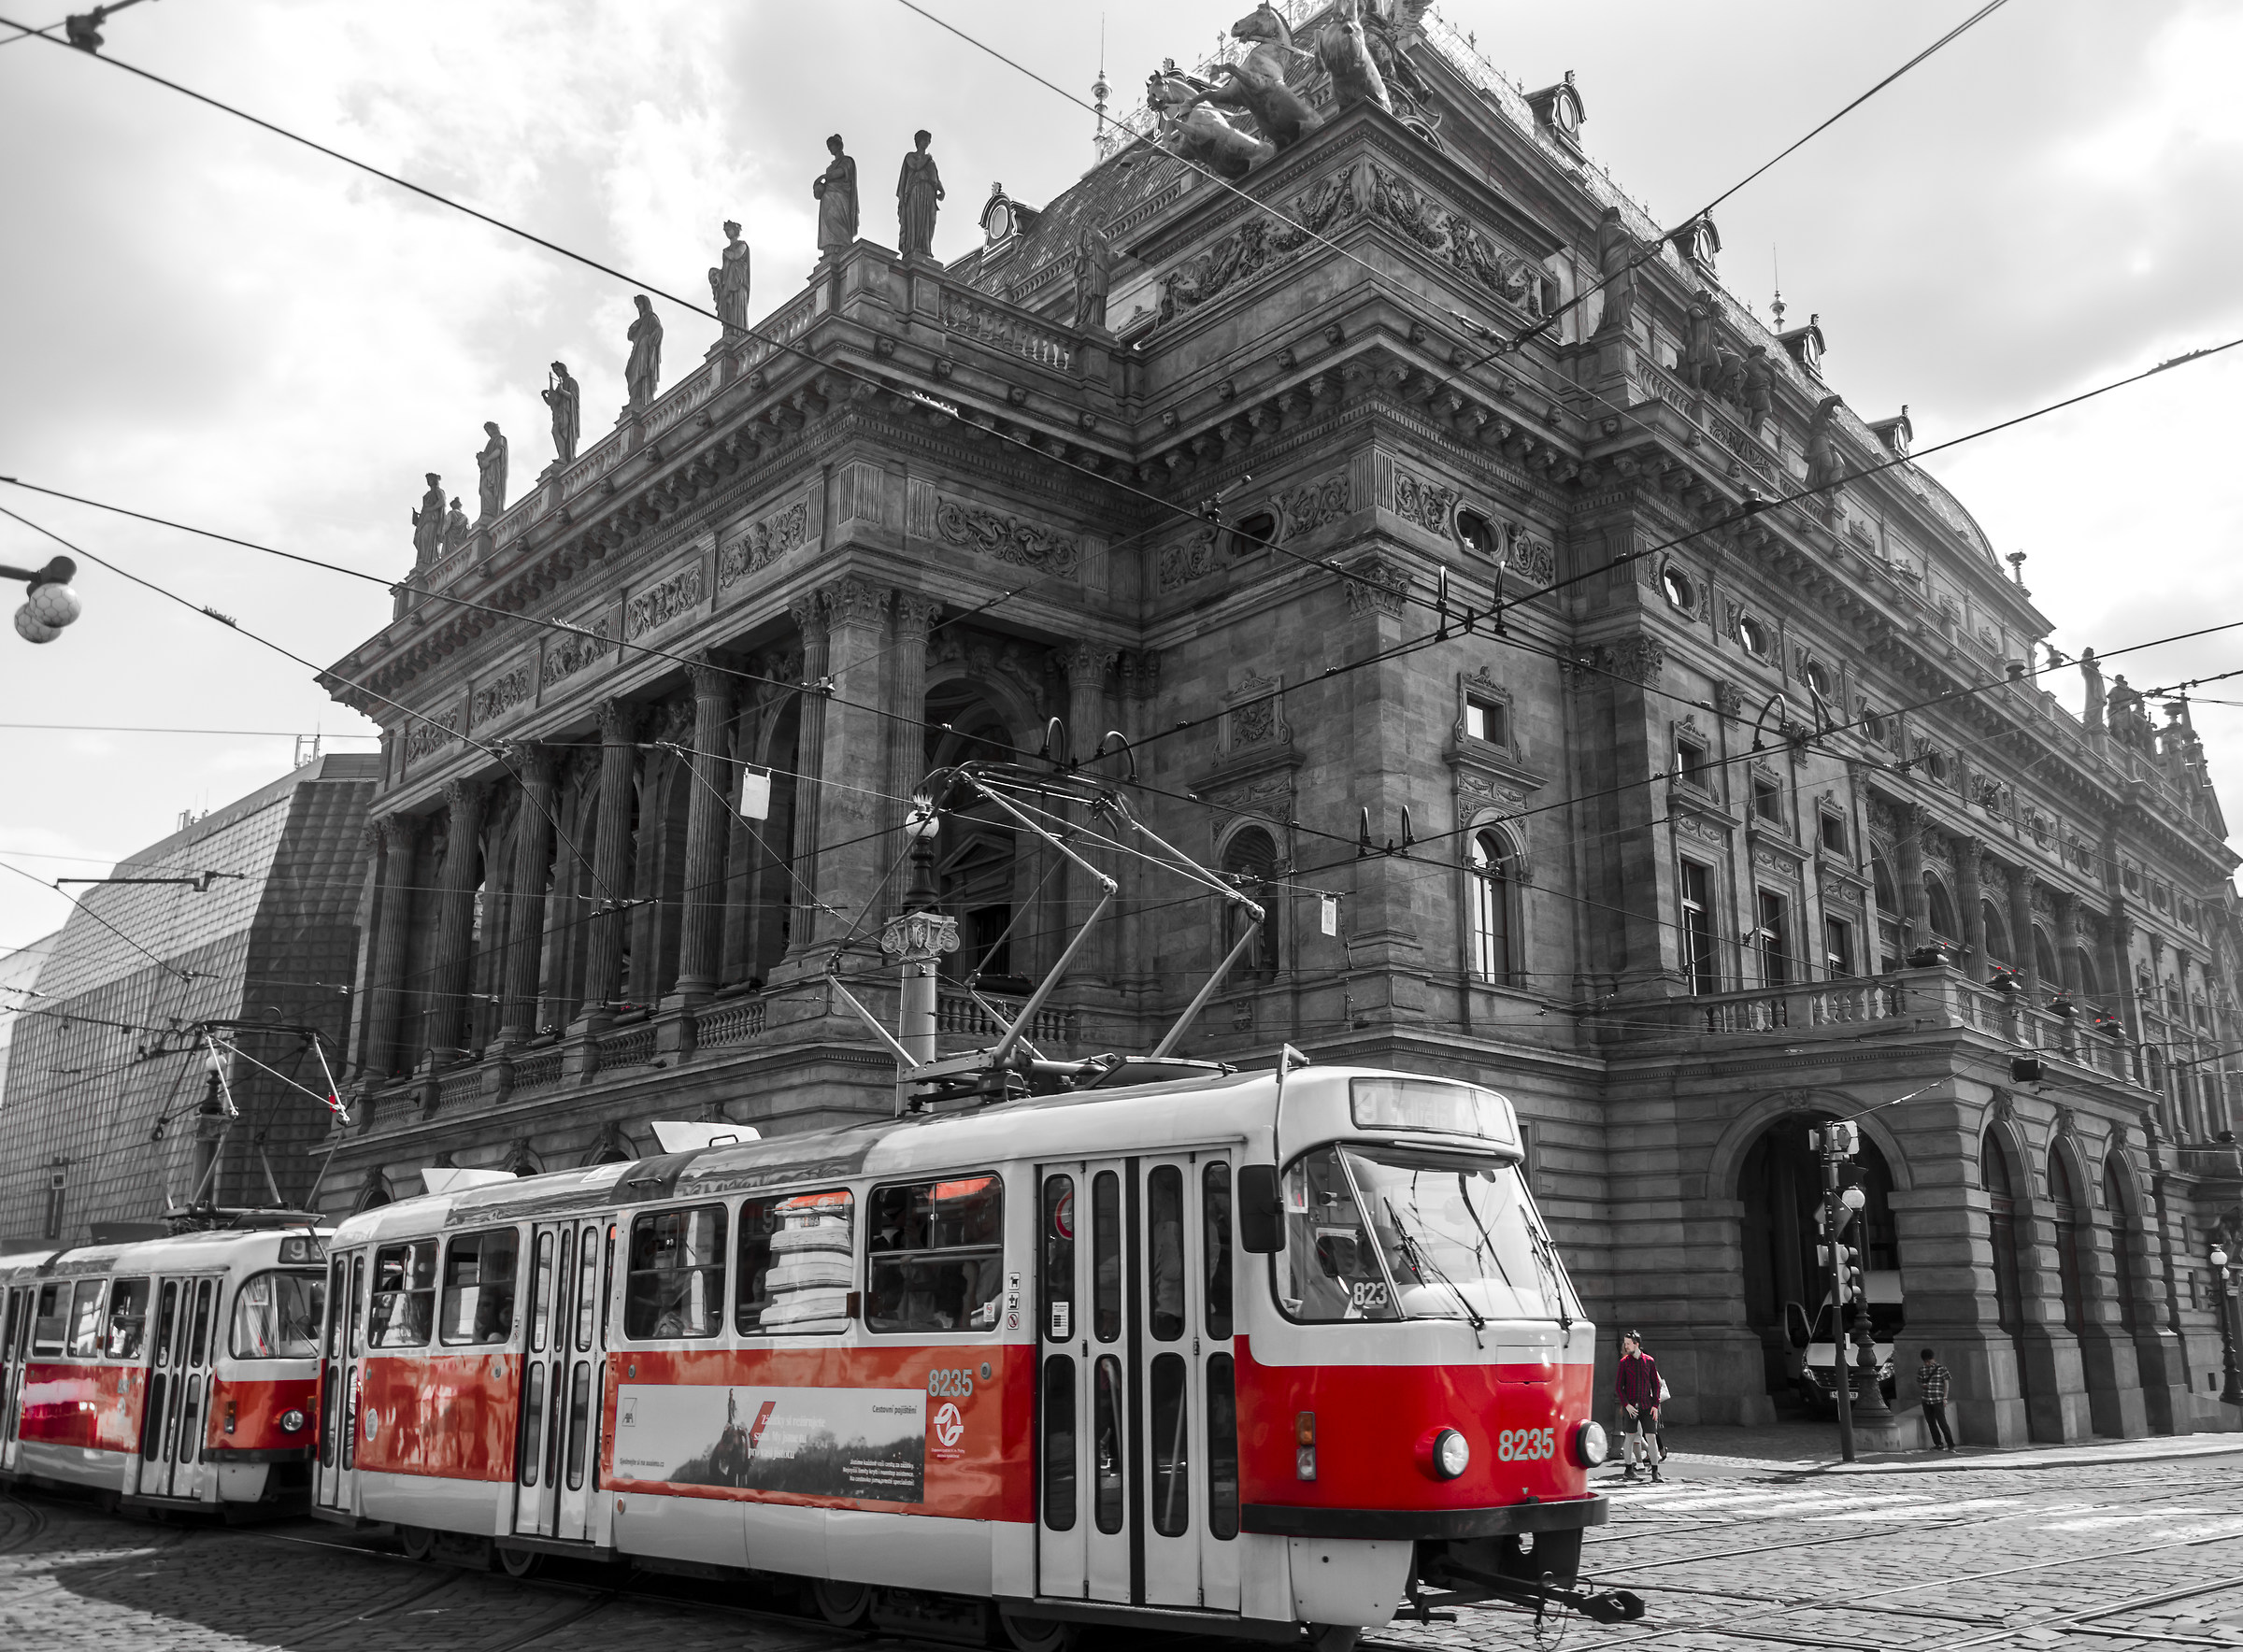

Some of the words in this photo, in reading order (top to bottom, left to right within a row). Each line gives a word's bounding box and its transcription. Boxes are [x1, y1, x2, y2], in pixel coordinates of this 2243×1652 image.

[291, 1241, 306, 1260] 9
[1353, 1282, 1388, 1305] 823
[928, 1368, 973, 1397] 8235
[1498, 1428, 1555, 1462] 8235
